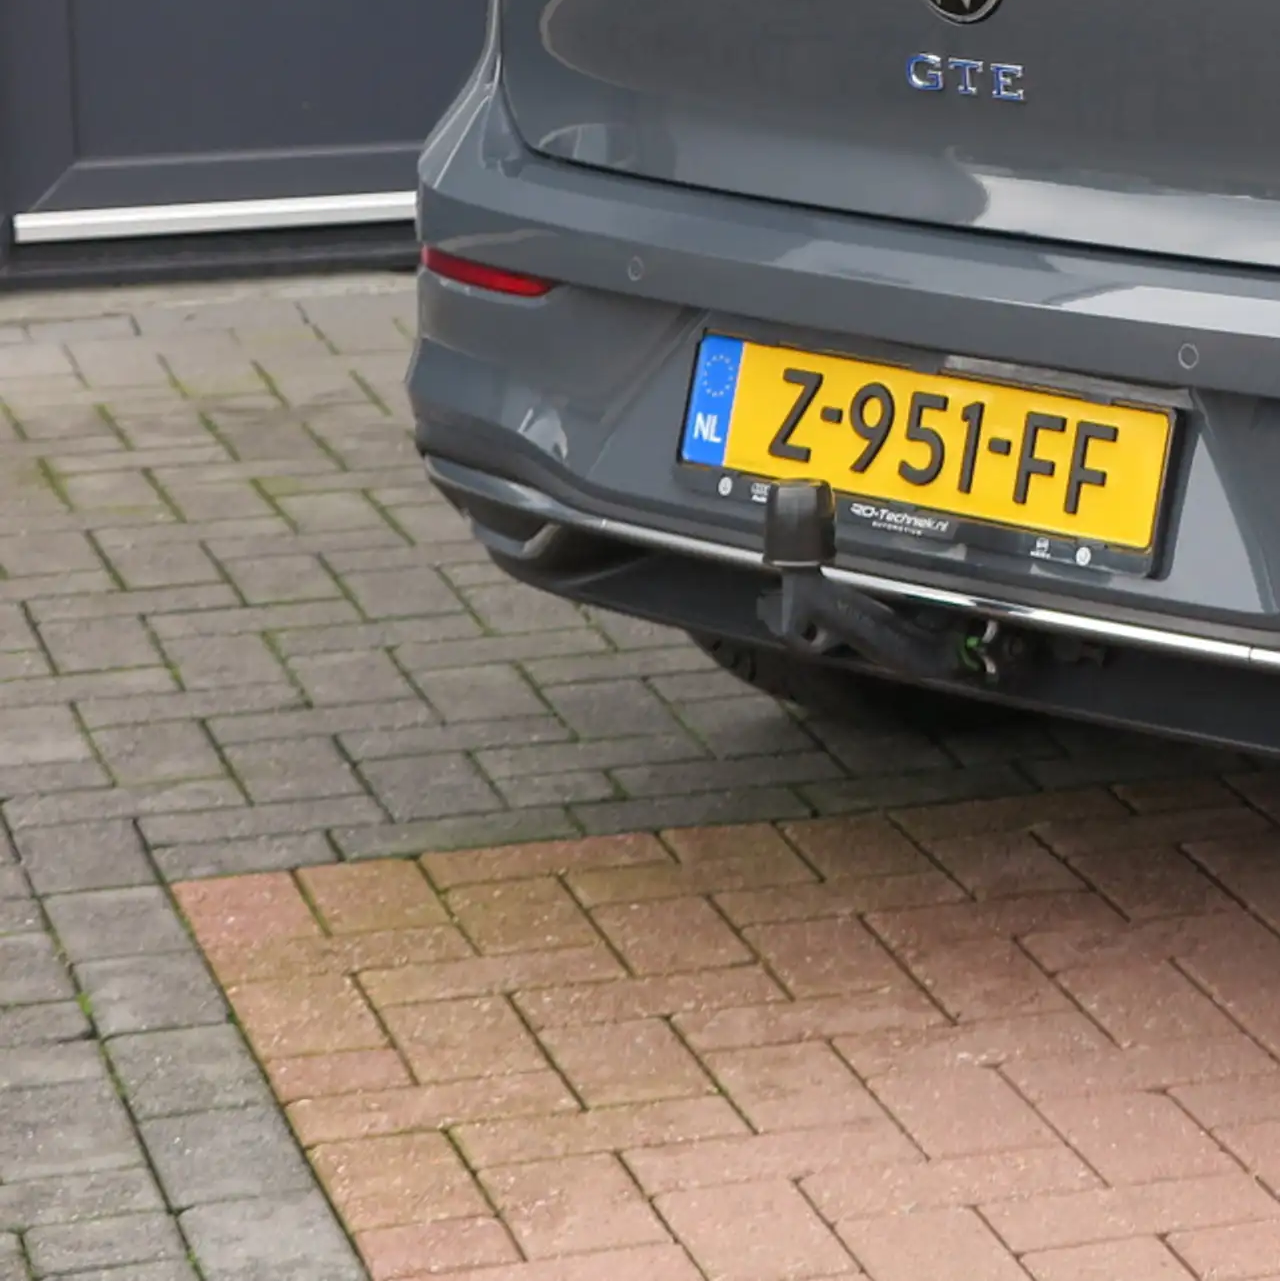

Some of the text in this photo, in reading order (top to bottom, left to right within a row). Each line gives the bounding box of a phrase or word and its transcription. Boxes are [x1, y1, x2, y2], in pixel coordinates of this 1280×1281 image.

[906, 52, 1026, 101] GTE
[694, 412, 722, 443] NL
[768, 367, 1118, 515] Z-951-FF
